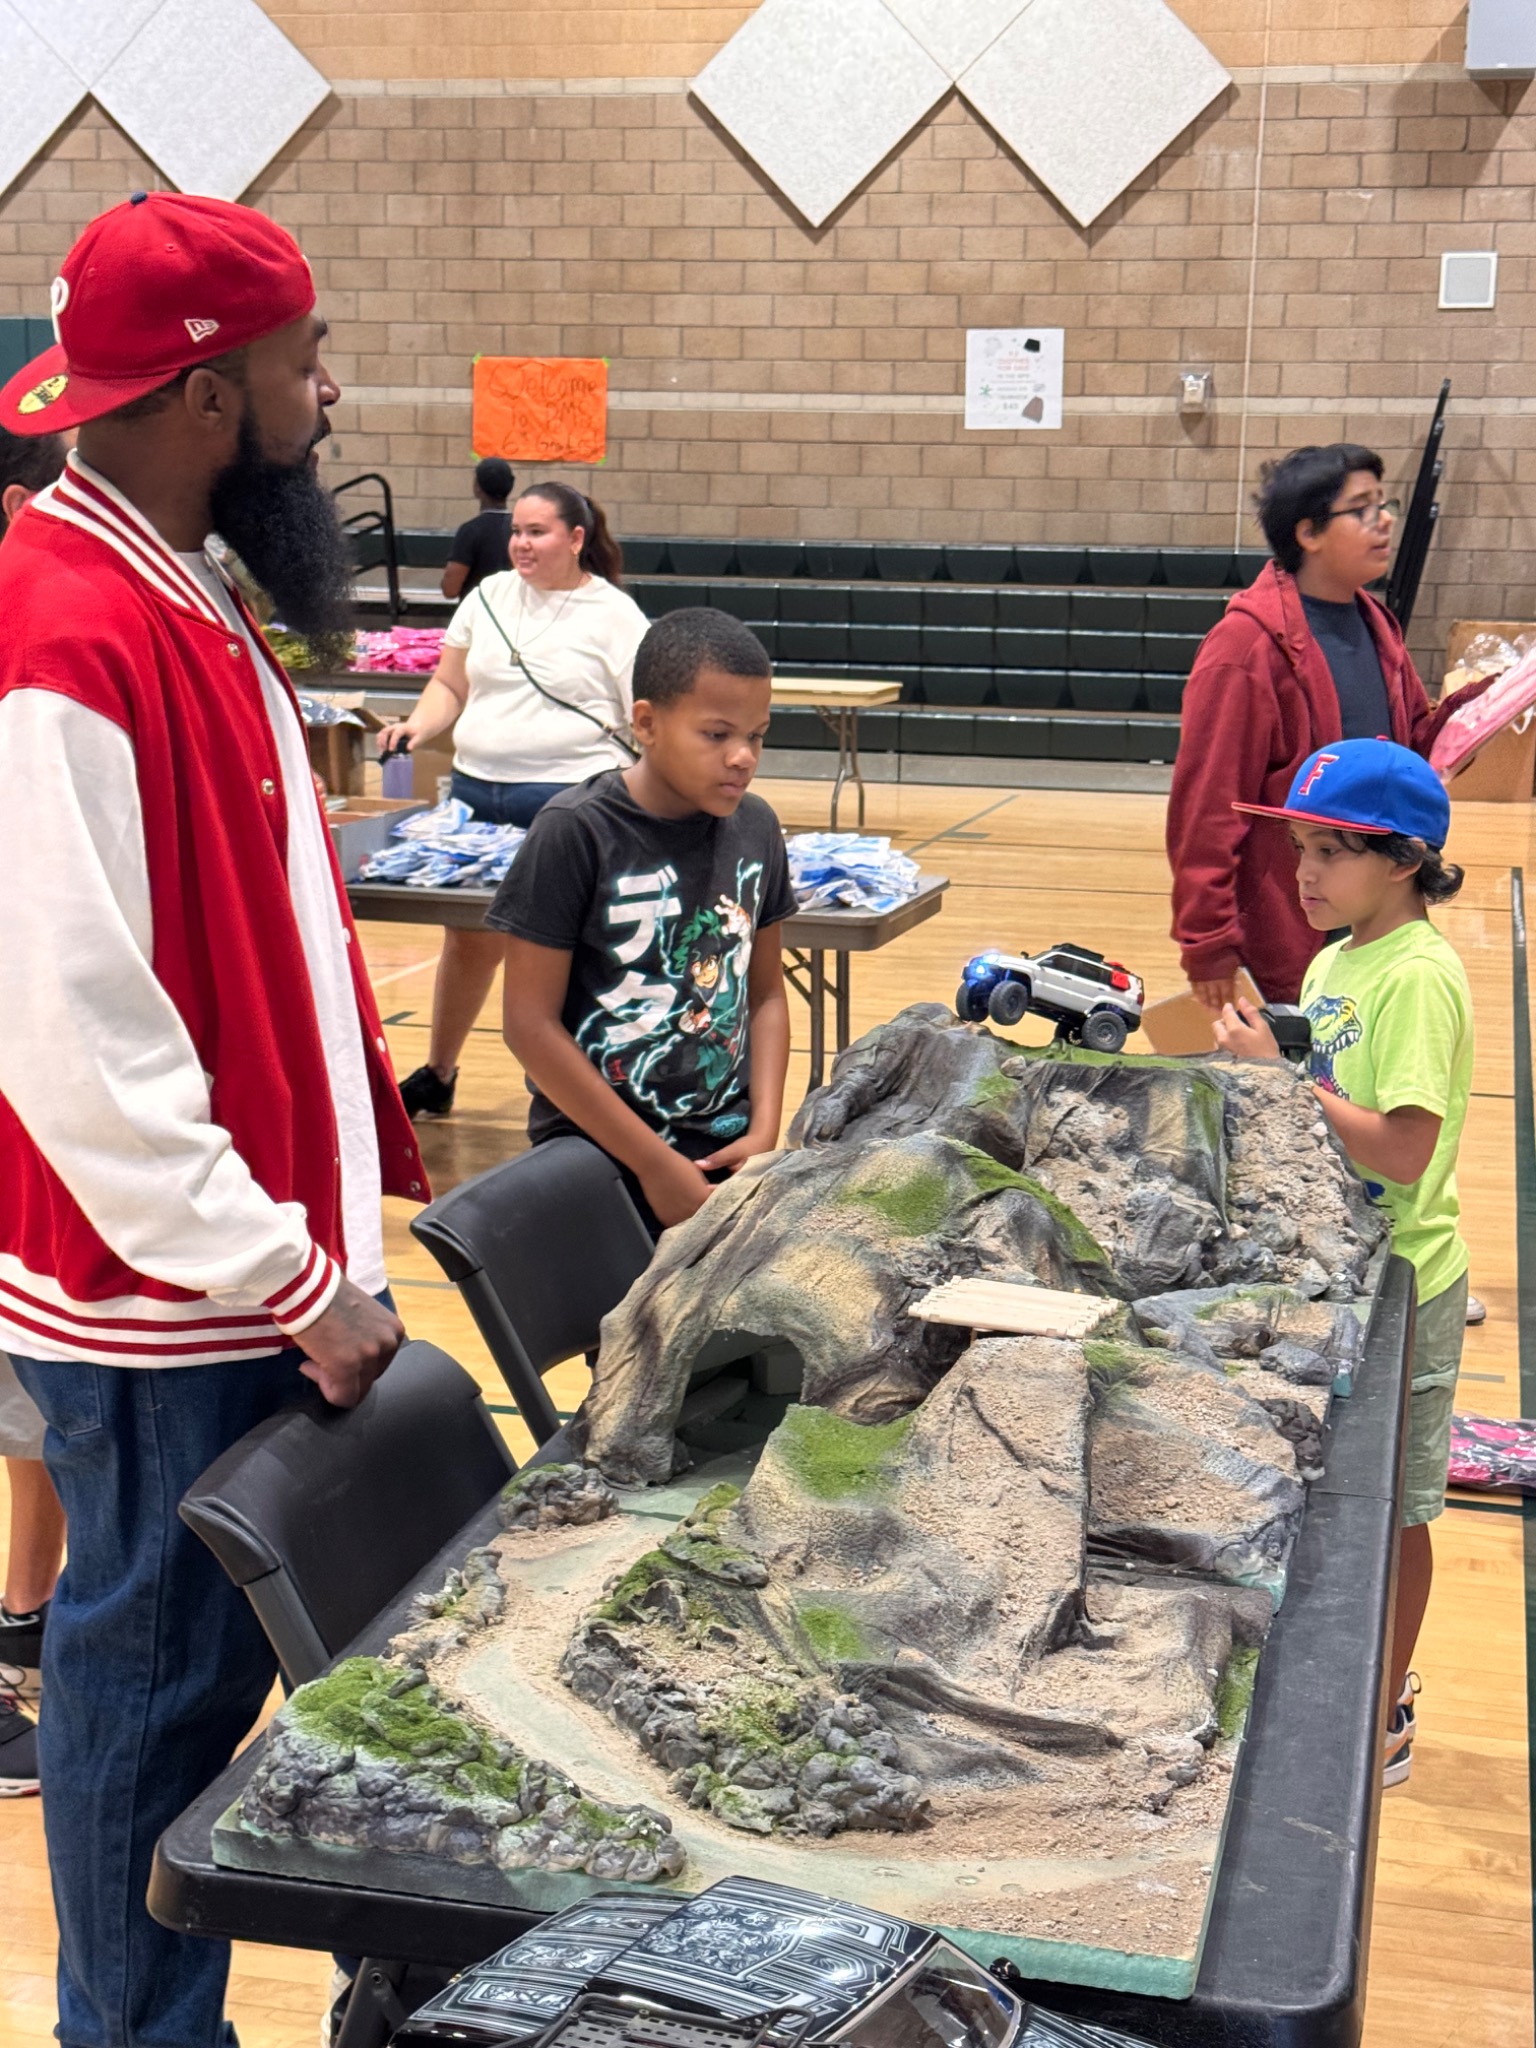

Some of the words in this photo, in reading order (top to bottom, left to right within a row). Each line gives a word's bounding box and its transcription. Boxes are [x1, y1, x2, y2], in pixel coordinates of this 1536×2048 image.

[488, 364, 598, 402] Welcome
[1297, 753, 1340, 796] F
[597, 864, 682, 1045] デク
